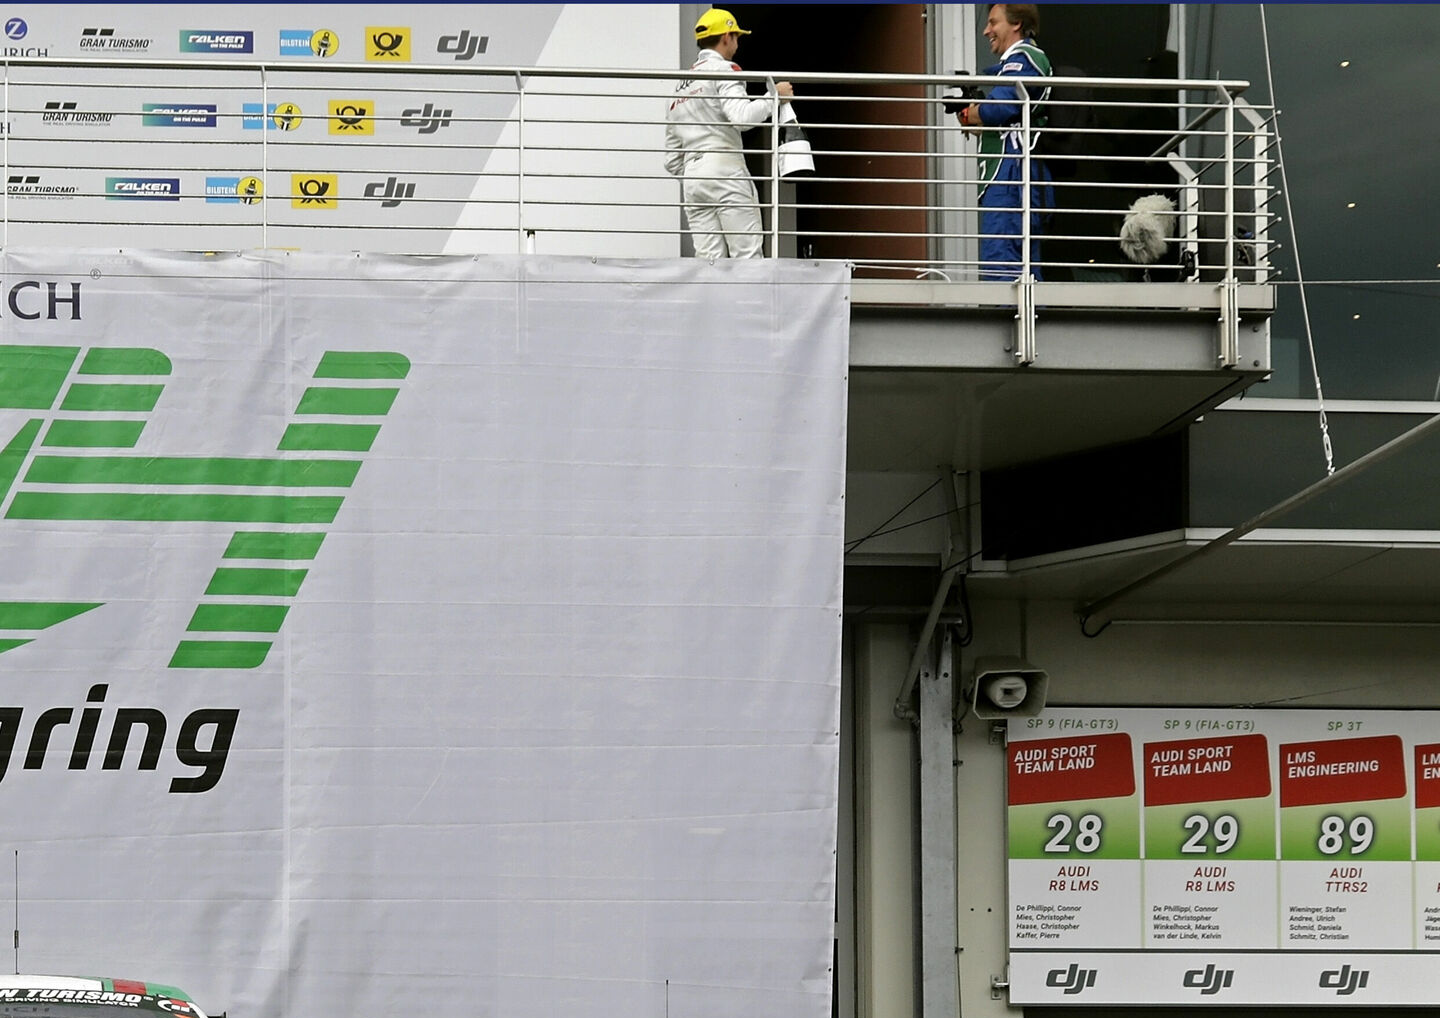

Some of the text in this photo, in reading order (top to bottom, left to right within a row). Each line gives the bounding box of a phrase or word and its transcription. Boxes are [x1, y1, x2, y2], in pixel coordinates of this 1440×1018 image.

[1027, 717, 1119, 730] SP 9 (FIA-GT3)
[1164, 719, 1255, 731] SP 9 (FIA-GT3)
[1327, 721, 1363, 731] SP 3T
[1014, 745, 1097, 762] AUDI SPORT
[1151, 746, 1233, 763] AUDI SPORT
[1287, 751, 1316, 764] LMS
[1016, 757, 1095, 774] TEAM LAND
[1153, 760, 1232, 777] TEAM LAND
[1288, 760, 1379, 779] ENGINEERING
[1044, 813, 1103, 853] 28
[1181, 815, 1239, 854] 29
[1318, 815, 1374, 855] 89
[1057, 866, 1091, 877] AUDI
[1193, 867, 1227, 878] AUDI
[1330, 867, 1363, 878] AUDI
[1049, 880, 1100, 891] R8 LMS
[1185, 881, 1236, 892] R8 LMS
[1326, 881, 1368, 893] TTRS2
[1036, 914, 1075, 922] Christopher
[1173, 914, 1212, 922] Christopher
[1041, 923, 1080, 931] Christopher
[26, 989, 142, 1004] TURISMO
